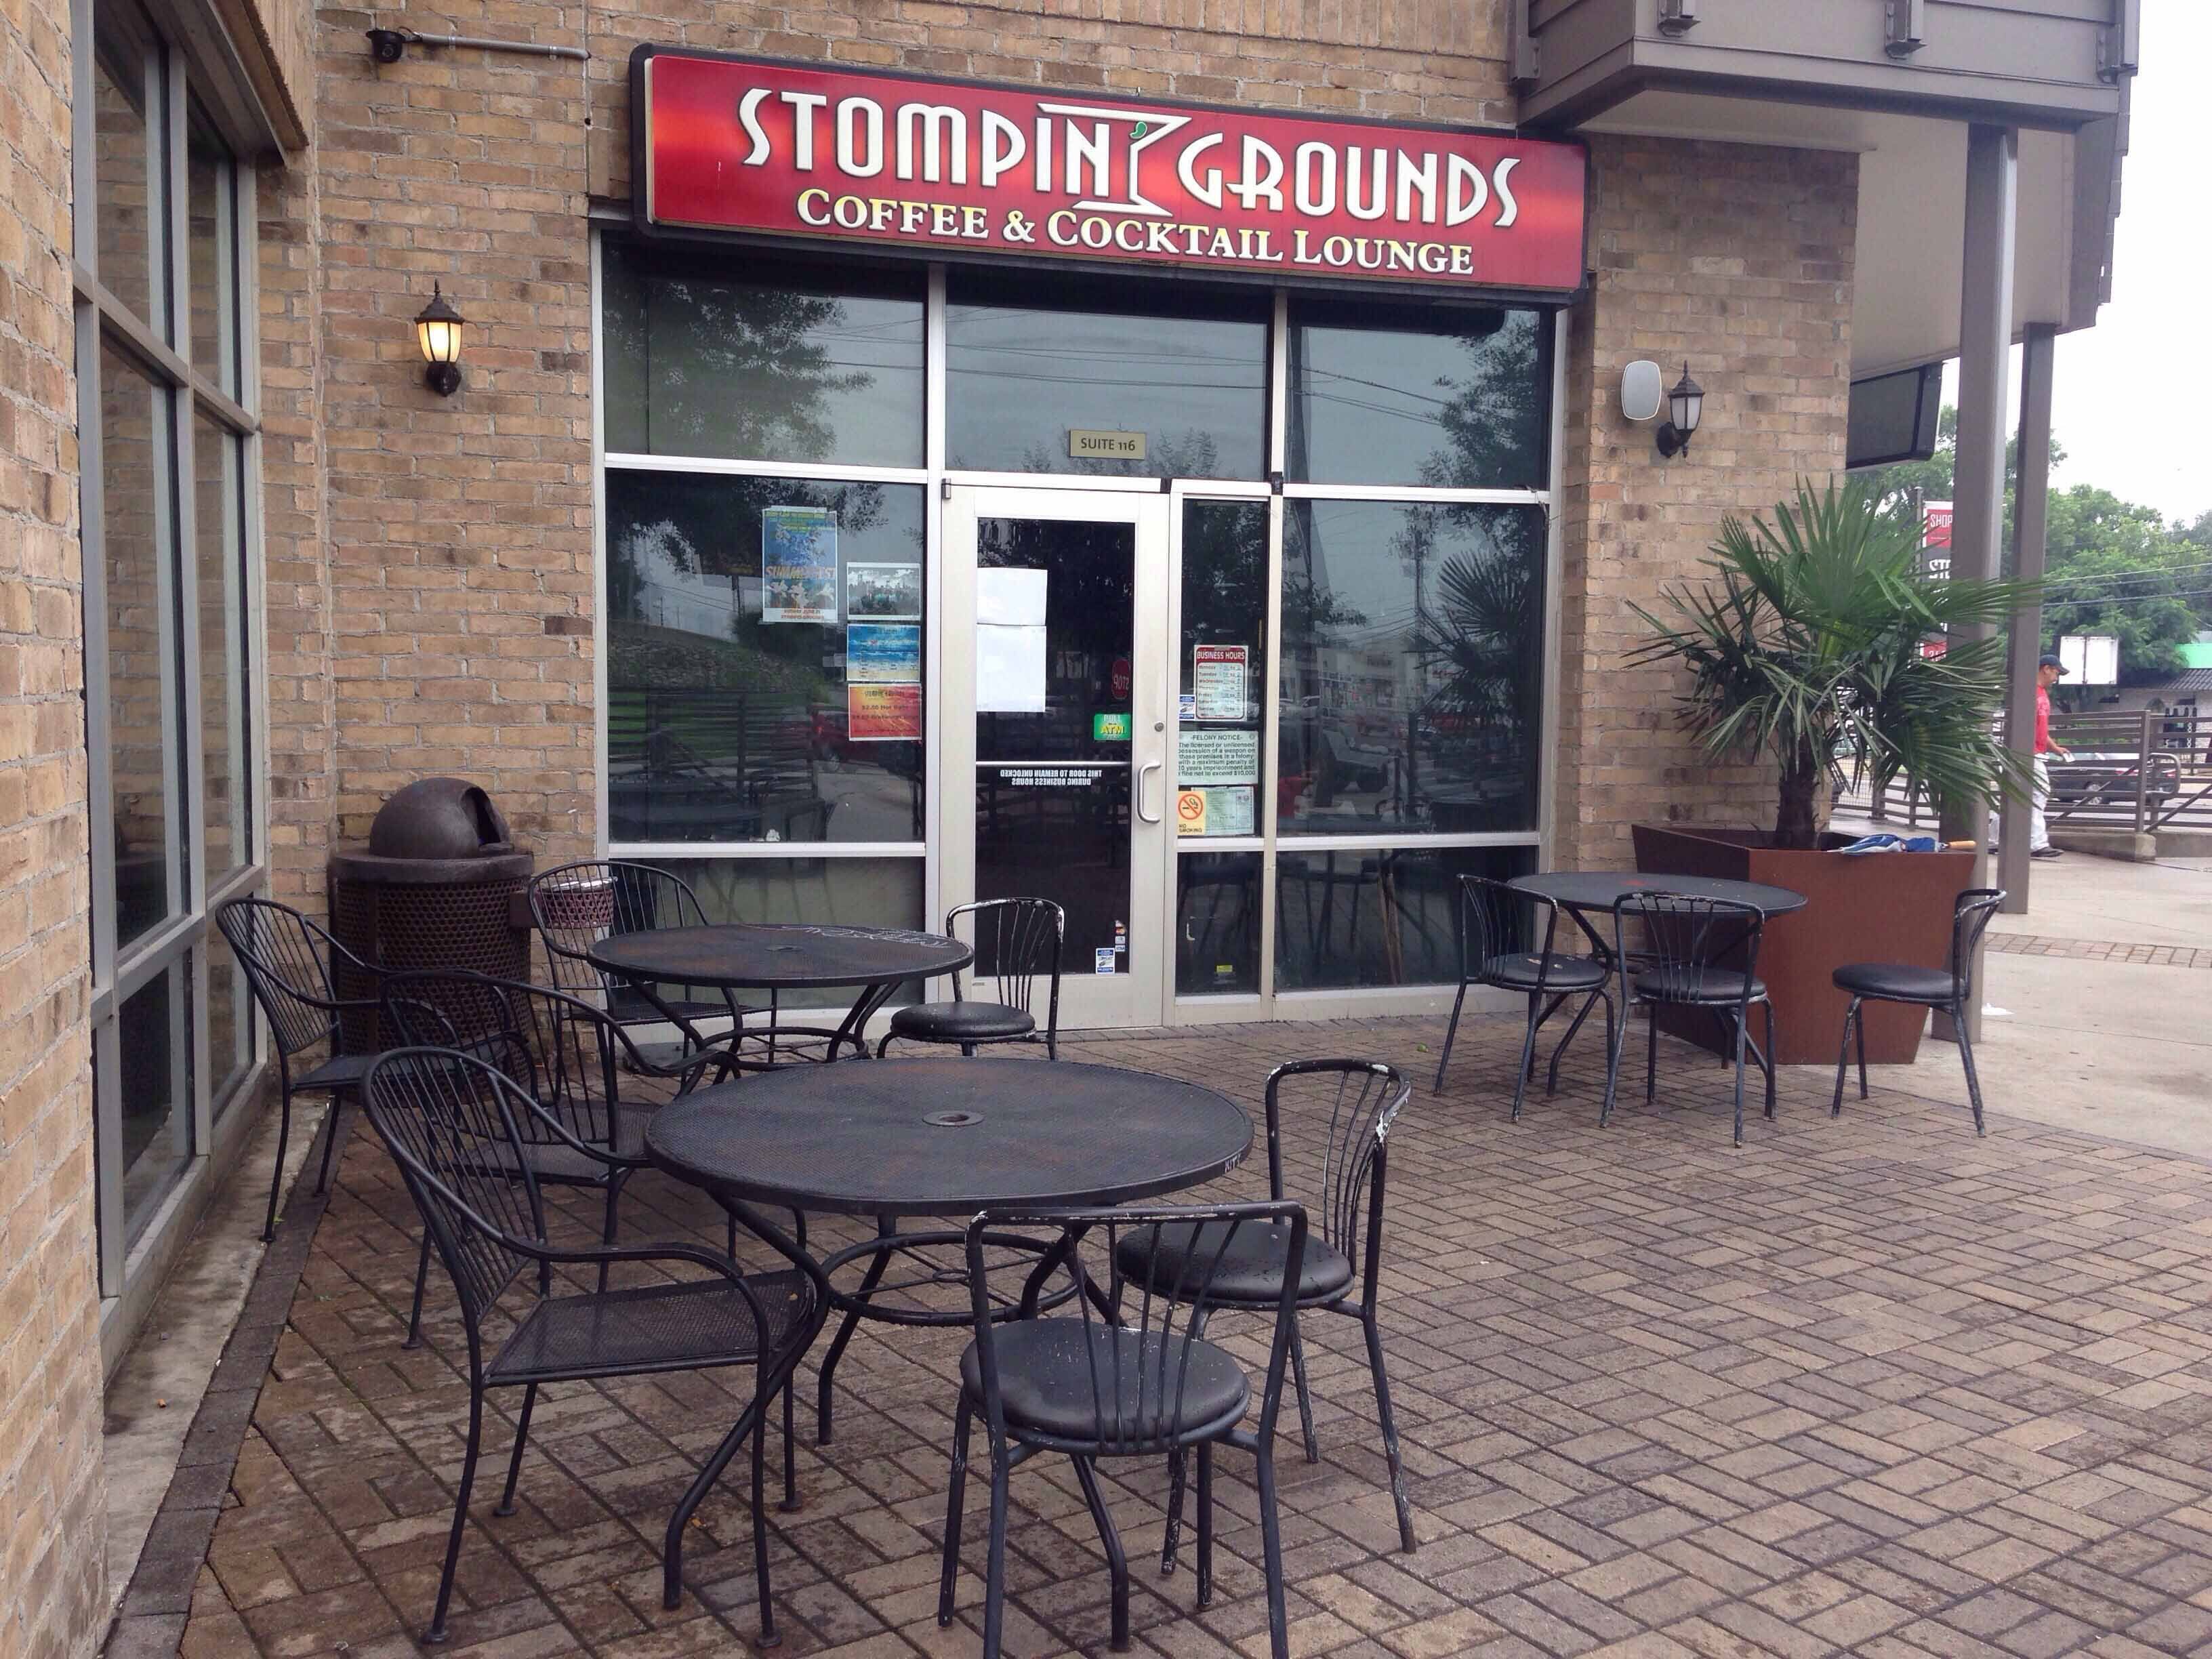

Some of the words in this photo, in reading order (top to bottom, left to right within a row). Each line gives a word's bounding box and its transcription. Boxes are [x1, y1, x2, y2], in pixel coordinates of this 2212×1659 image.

[1176, 132, 1522, 228] GROUNDS
[797, 188, 989, 240] COFFEE
[1002, 210, 1036, 243] &
[1047, 210, 1284, 262] COCKTAIL
[1294, 229, 1474, 275] LOUNGE
[1080, 437, 1115, 450] SUITE
[1118, 440, 1136, 451] 116
[1197, 651, 1224, 659] BUSINESS
[1225, 651, 1245, 659] HOURS
[1100, 726, 1126, 734] ATM
